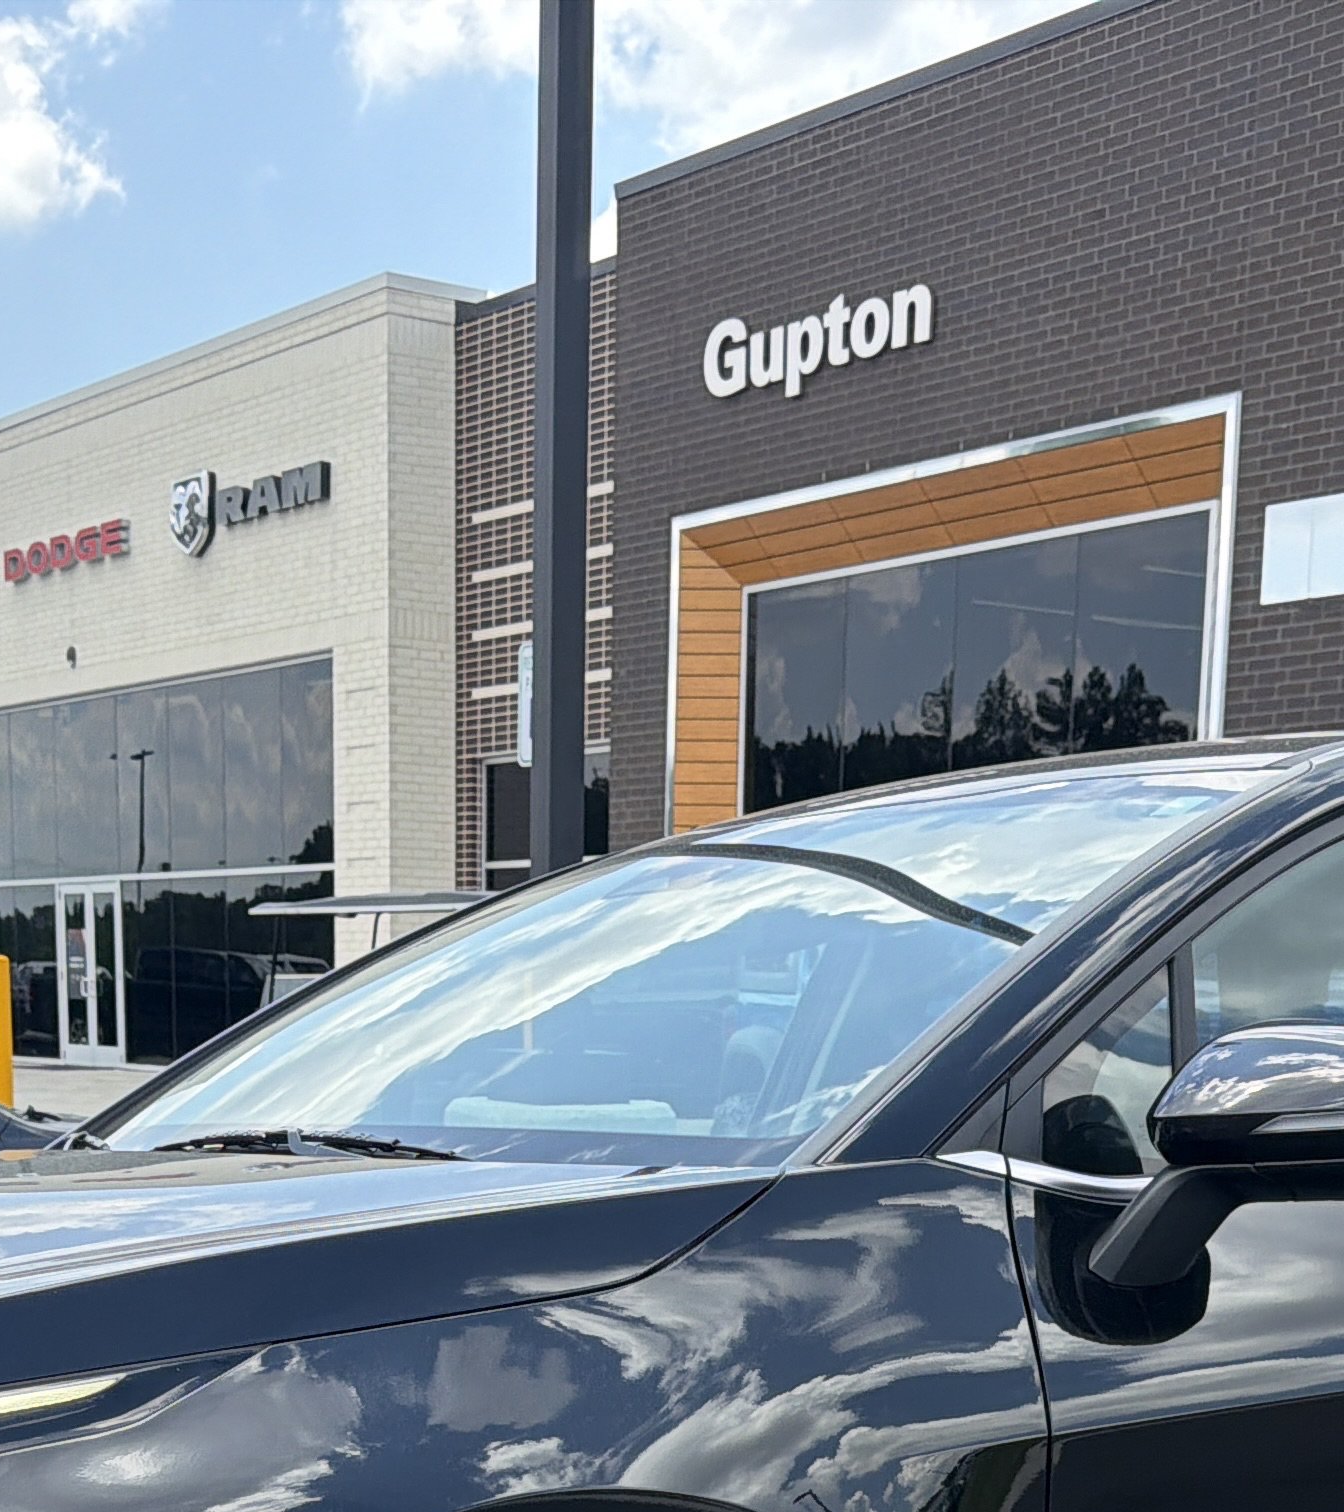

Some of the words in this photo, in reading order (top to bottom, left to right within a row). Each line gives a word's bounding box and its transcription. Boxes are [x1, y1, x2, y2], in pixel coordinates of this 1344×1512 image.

[704, 284, 932, 398] Gupton
[216, 461, 331, 525] RAM
[3, 519, 126, 583] DODGE
